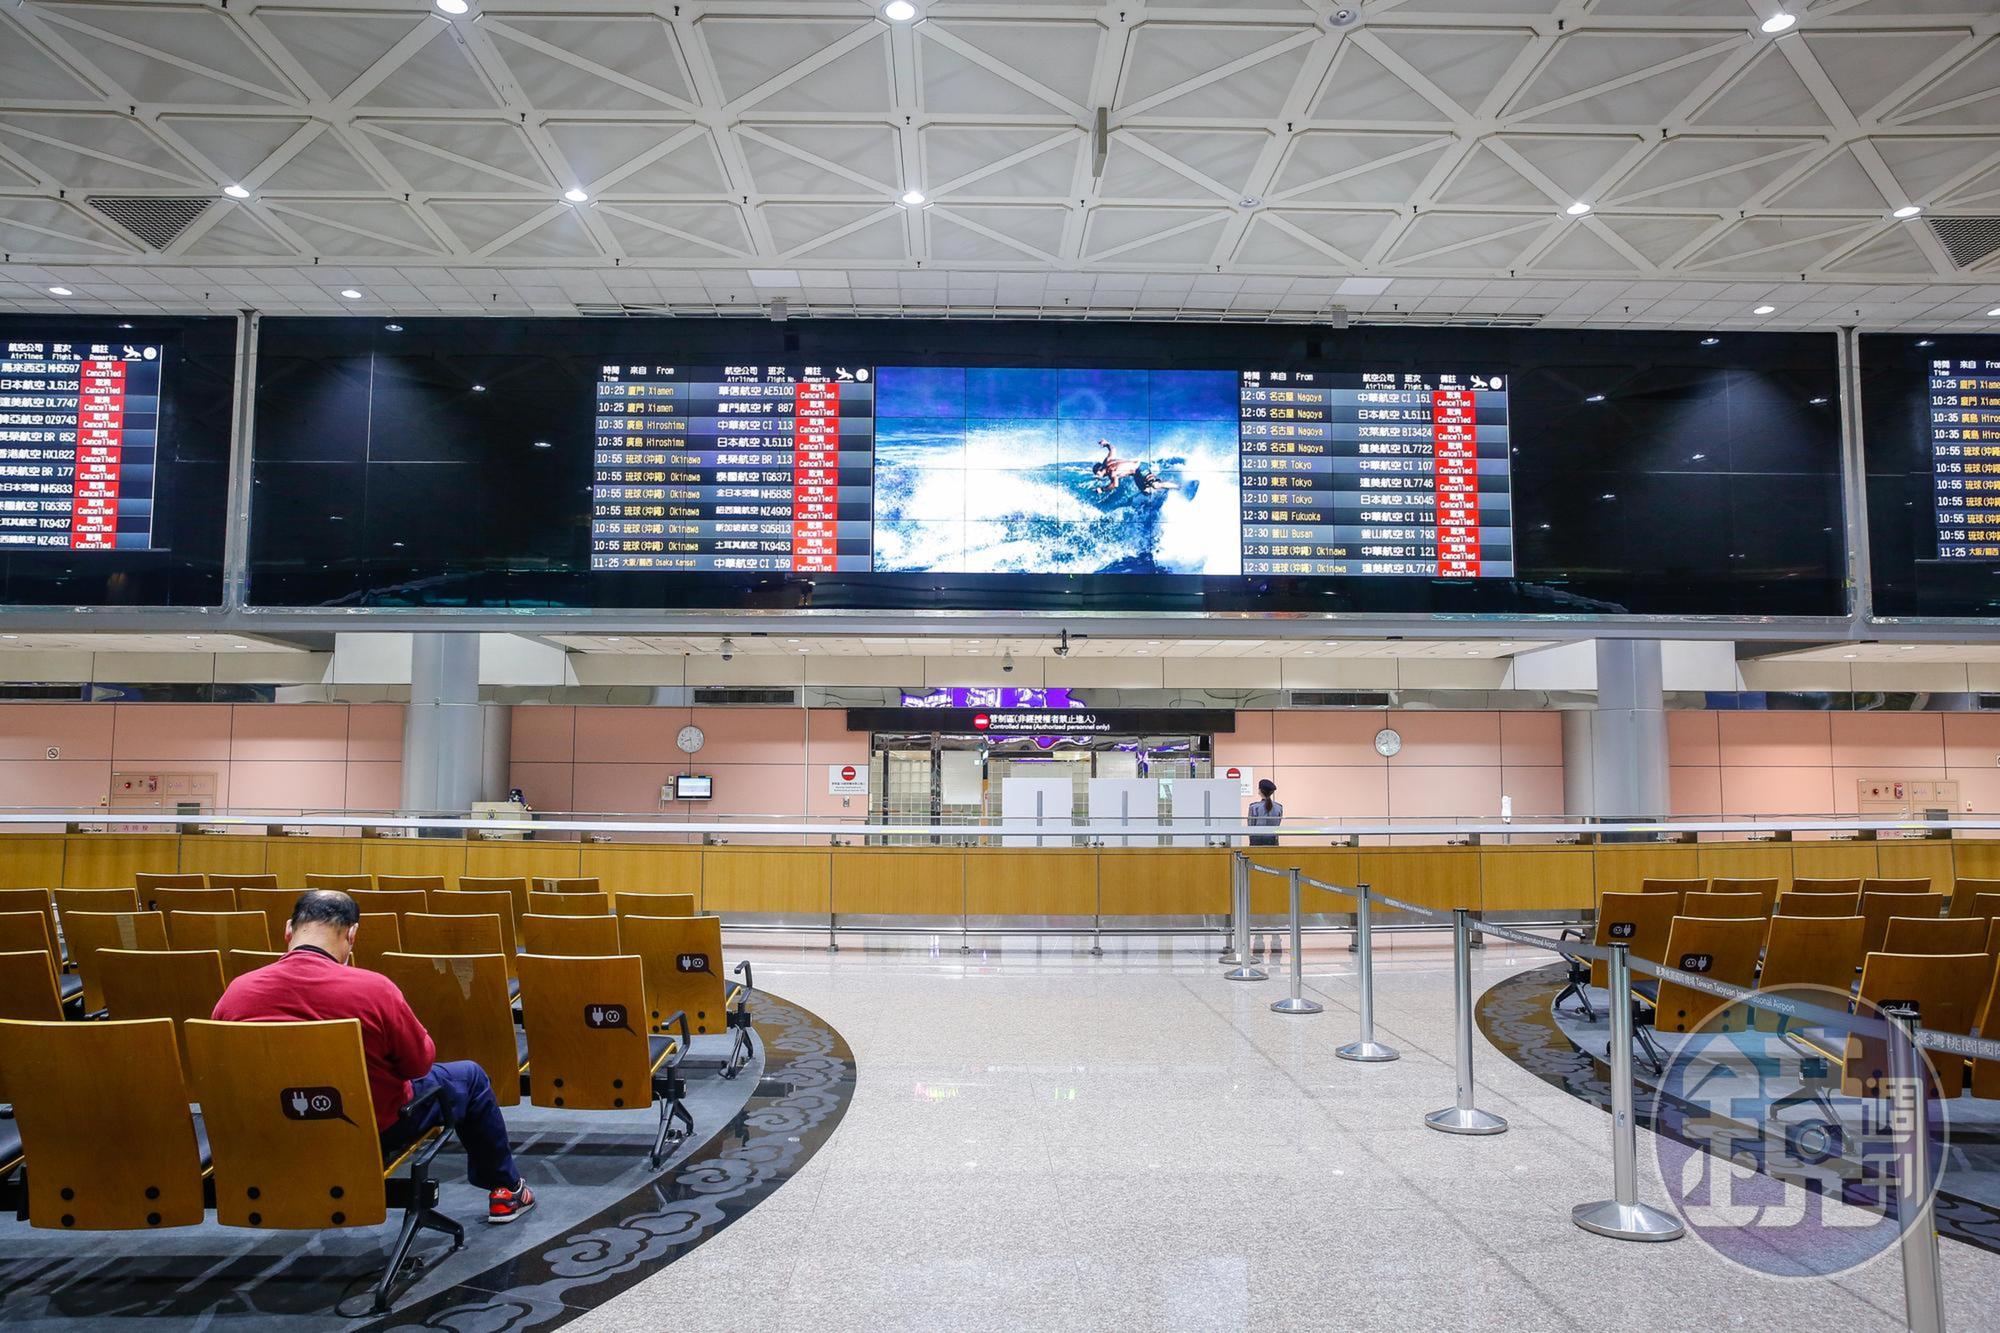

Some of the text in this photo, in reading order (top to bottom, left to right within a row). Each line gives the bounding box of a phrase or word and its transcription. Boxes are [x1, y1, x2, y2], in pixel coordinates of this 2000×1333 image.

[8, 343, 43, 352] 航空公司
[47, 363, 80, 373] MH5597
[1933, 360, 1977, 369] 時間 來自
[86, 370, 122, 378] Cancelled
[603, 365, 675, 375] 時間 來自 From
[1243, 371, 1314, 381] 時間 來自 From
[0, 380, 79, 390] 日本航空 JL5125
[1931, 379, 1957, 389] 10:25
[599, 385, 794, 396] 10:25 Xiamen AE5100
[800, 391, 835, 399] Cancelled
[1241, 391, 1431, 403] 12:05 名古屋 Nagoya 中華航空 CI 151
[1932, 396, 1958, 406] 10:25
[46, 398, 78, 408] DL7747
[84, 404, 120, 412] Cancelled
[599, 403, 794, 413] 10:25 Xiamen MF 887
[1437, 399, 1471, 407] Cancelled
[1241, 408, 1431, 420] 12:05 名古屋 Nagoya 日本航空 JL5111
[1933, 413, 1959, 423] 10:35
[45, 415, 77, 425] OZ9743
[598, 420, 793, 431] 10:35 Hiroshima 中華航空 CI 113
[799, 426, 835, 434] Cancelled
[1241, 425, 1267, 435] 12:05
[1270, 425, 1295, 436] 名古屋
[1297, 426, 1324, 437] Nagoya
[1934, 430, 1960, 439] 10:35
[44, 432, 76, 442] BR 852
[598, 437, 793, 448] 10:35 Hiroshima 日本航空 JL5119
[1242, 442, 1433, 454] 12:05 名古屋 Nagoya DL7722
[1935, 446, 1961, 456] 10:55
[42, 449, 75, 460] HX1822
[597, 454, 793, 465] 10:55 Okinawa BR 113
[1242, 459, 1433, 472] 12:10 Tokyo 中華航空 CI 107
[1936, 463, 1962, 473] 10:55
[41, 466, 74, 477] BR 177
[596, 471, 792, 482] 10:55 Okinawa TG6371
[1242, 477, 1434, 488] 12:10 Tokyo DL7746
[1937, 480, 1963, 490] 10:55
[40, 484, 73, 494] NH5833
[596, 489, 792, 499] 10:55 Okinawa NH5835
[1242, 494, 1435, 506] 12:10 Tokyo 日本航空 JL5045
[1938, 497, 1964, 507] 10:55
[40, 501, 72, 511] TG6355
[595, 506, 792, 517] 10:55 Okinawa NZ4909
[1243, 511, 1435, 523] 12:30 Fukuoka 中華航空 CI 111
[1939, 514, 1965, 523] 10:55
[39, 518, 71, 529] TK9437
[595, 523, 621, 533] 10:55
[668, 524, 699, 534] Okinawa
[1243, 528, 1435, 540] 12:30 Busan BX 793
[1940, 530, 1966, 540] 10:55
[37, 536, 69, 546] NZ4931
[594, 541, 791, 551] 10:55 Okinawa TK9453
[1243, 545, 1436, 557] 12:30 Okinawa 中華航空 CI 121
[1941, 547, 1966, 557] 11:25
[593, 558, 619, 568] 11:25
[714, 558, 758, 569] 中華航空
[759, 558, 769, 569] CI
[775, 558, 791, 569] 159
[1243, 563, 1436, 575] 12:30 Okinawa DL7747
[1033, 723, 1065, 731] (Authorized
[1067, 723, 1095, 731] personnel
[1773, 999, 1795, 1013] Airport
